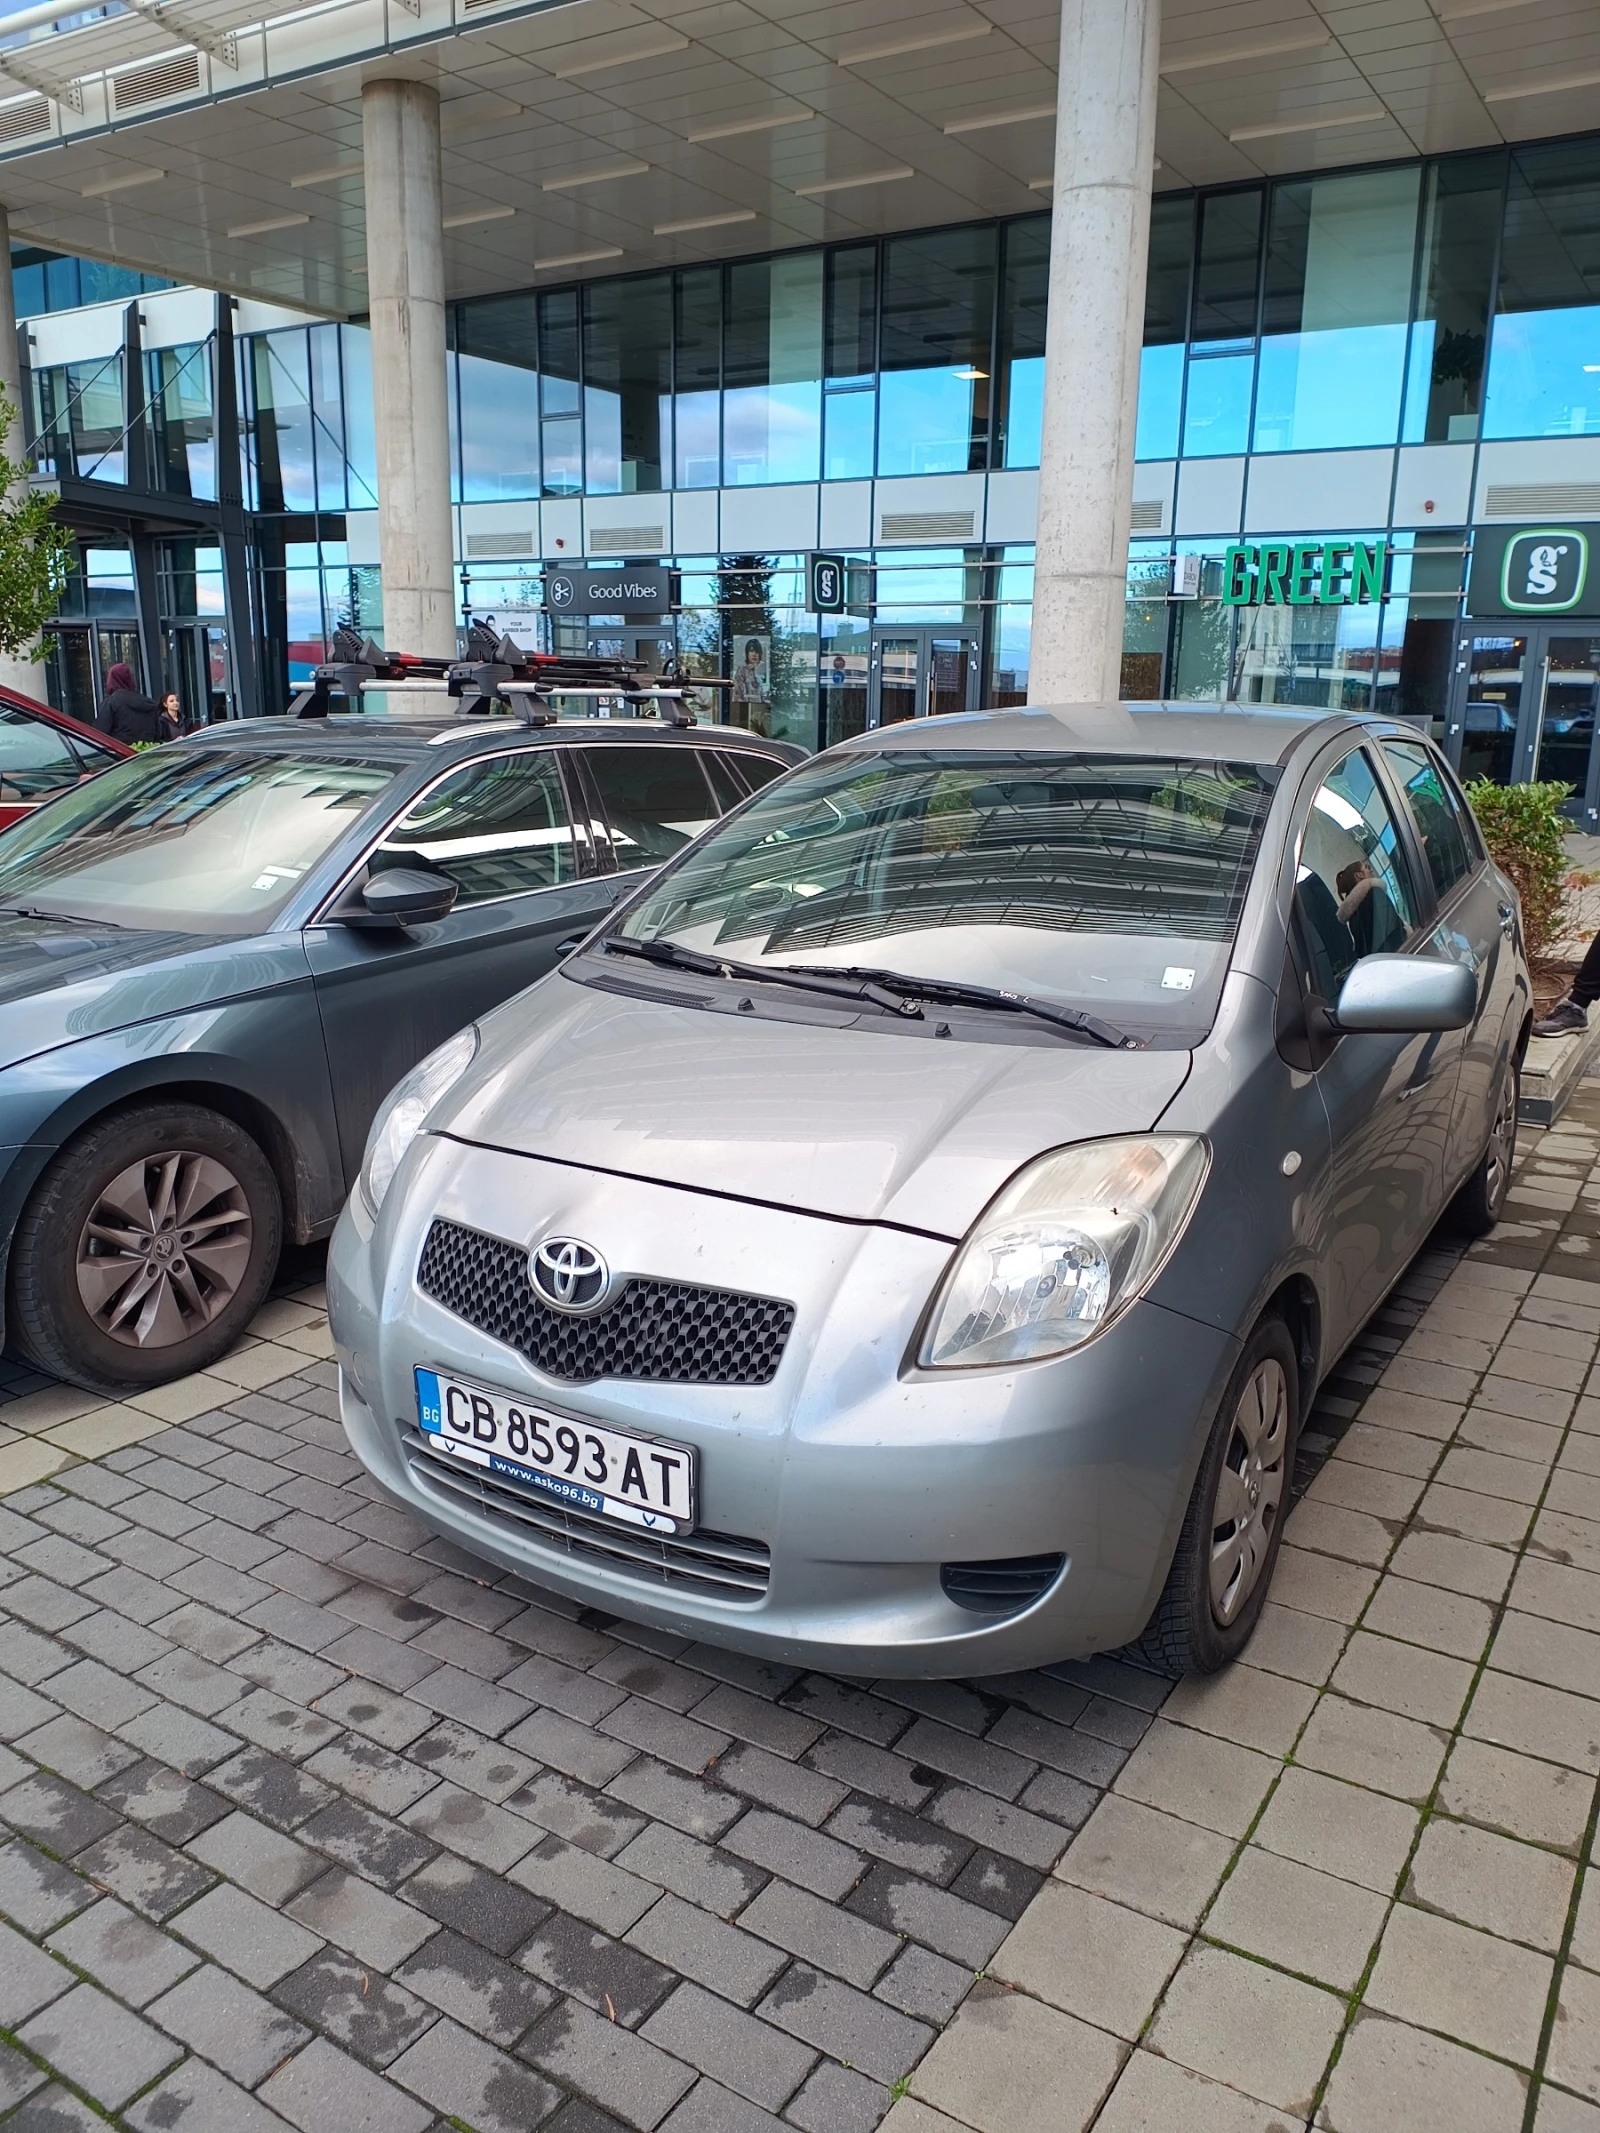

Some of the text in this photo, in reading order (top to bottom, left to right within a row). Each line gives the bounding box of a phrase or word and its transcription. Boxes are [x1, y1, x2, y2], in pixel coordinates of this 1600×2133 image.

[588, 582, 657, 599] Good Vibes
[1222, 540, 1387, 605] GREEN
[422, 1405, 440, 1424] BG
[446, 1386, 680, 1507] CB 8593 AT
[494, 1458, 600, 1509] www.asko96.bg
